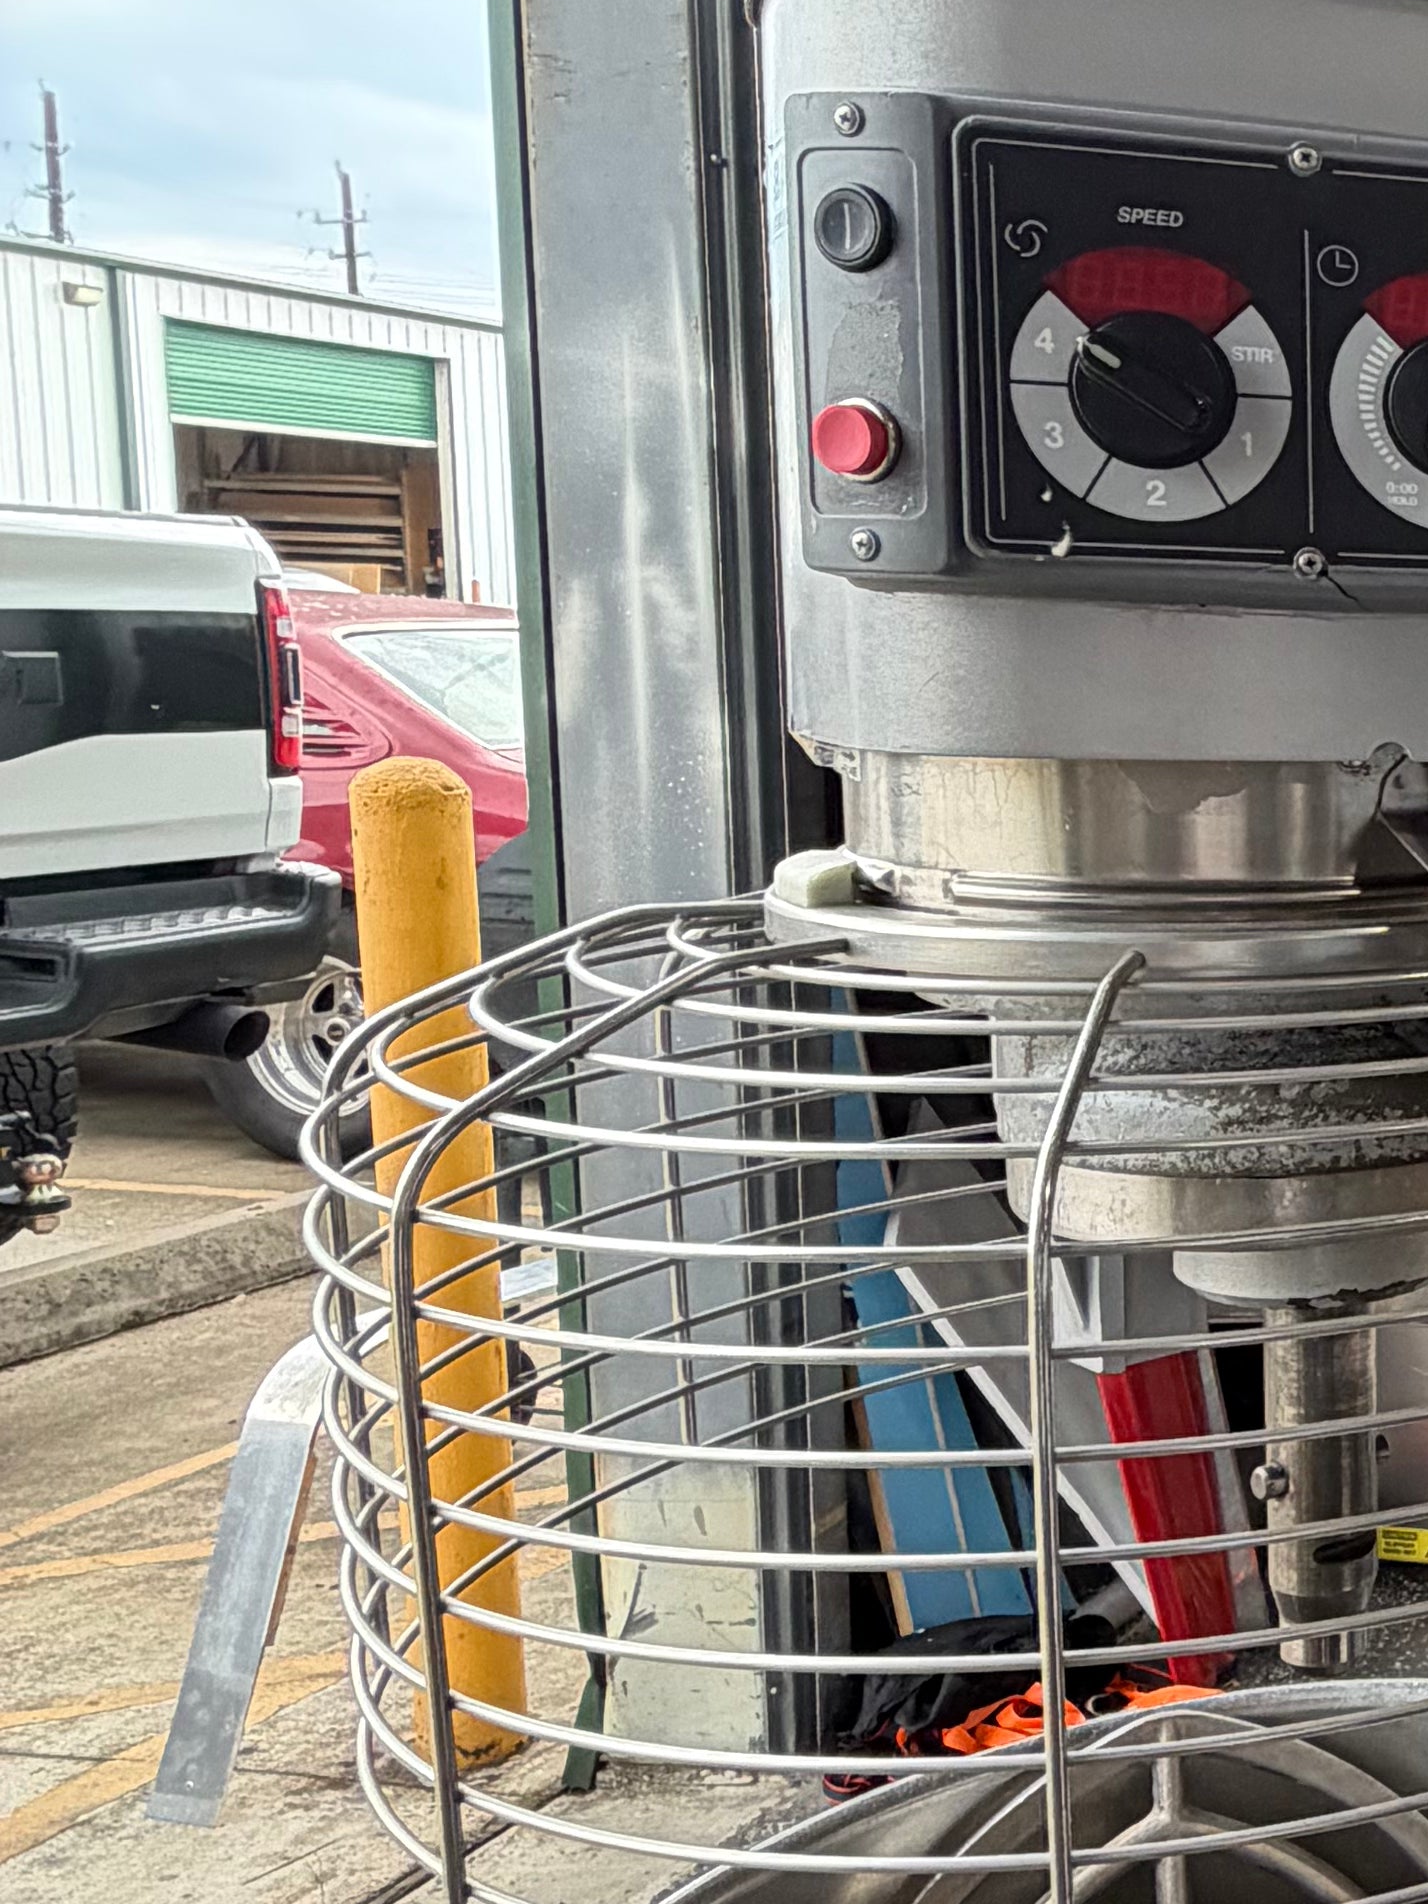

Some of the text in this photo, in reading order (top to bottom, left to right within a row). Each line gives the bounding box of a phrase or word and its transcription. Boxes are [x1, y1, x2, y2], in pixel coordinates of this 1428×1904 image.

[1117, 206, 1184, 227] SPEED
[1034, 327, 1054, 353] 4
[1232, 346, 1274, 364] STIR
[1044, 421, 1064, 449] 3
[1240, 431, 1252, 457] 1
[1146, 479, 1167, 507] 2
